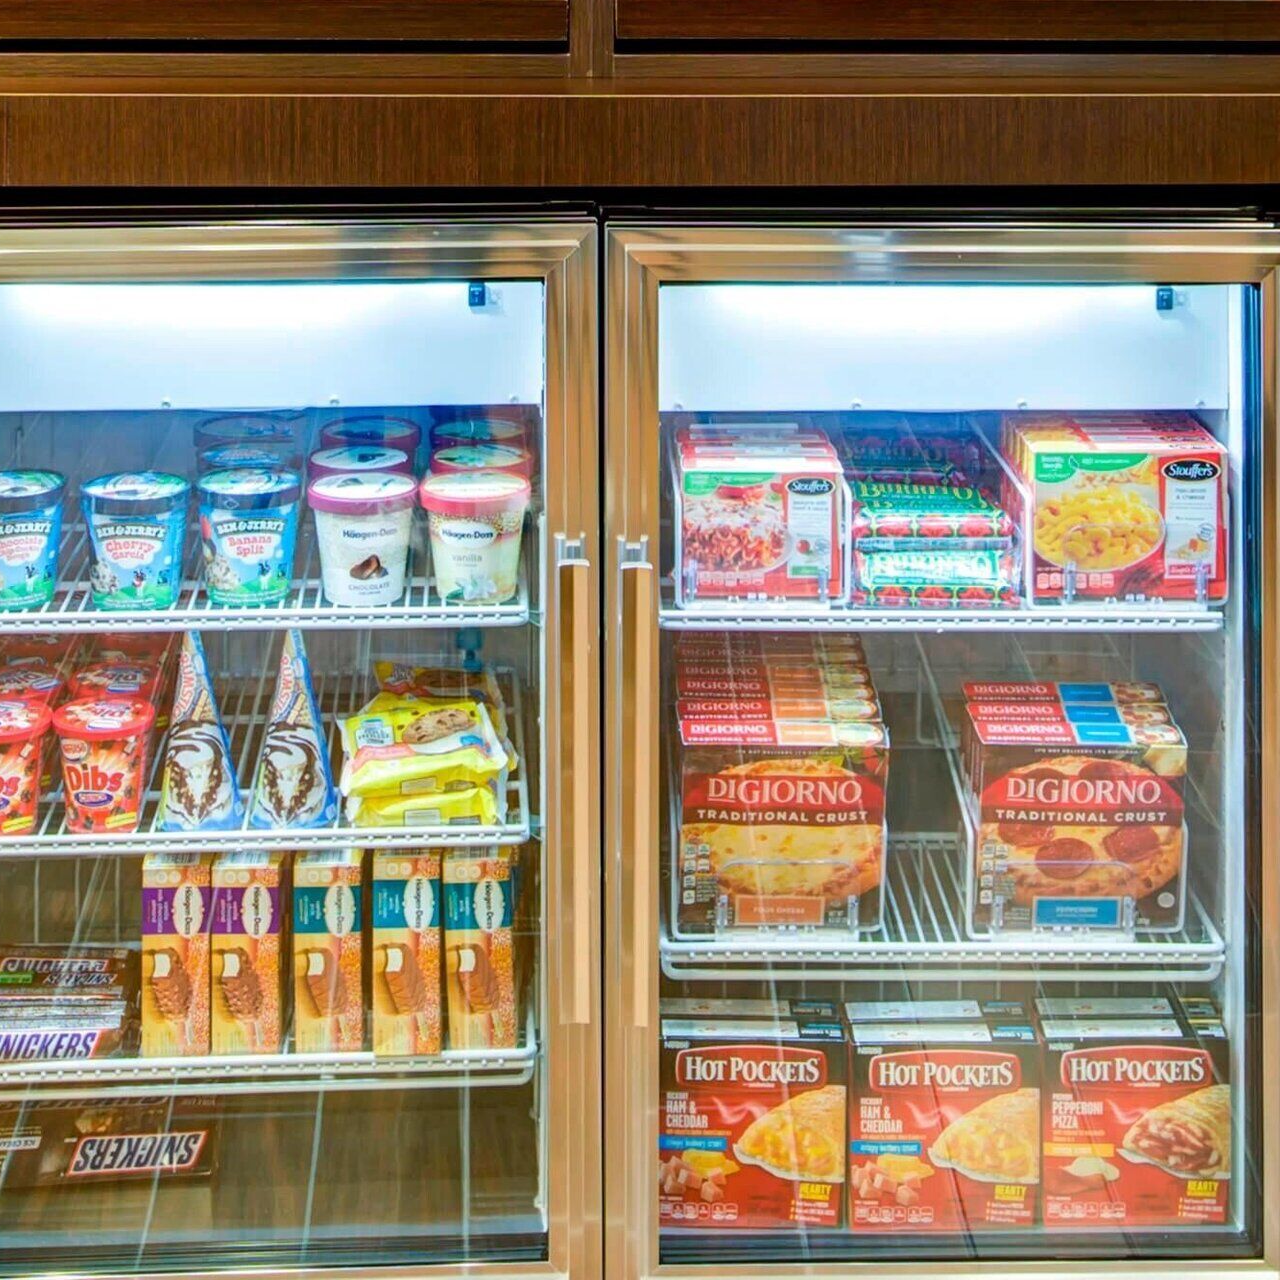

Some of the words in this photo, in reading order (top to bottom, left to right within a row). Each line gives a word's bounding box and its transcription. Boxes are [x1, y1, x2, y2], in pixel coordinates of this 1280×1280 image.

[1168, 464, 1214, 479] Stouffer's
[790, 480, 832, 494] Stouffer's
[14, 522, 52, 533] JERRY'S
[126, 526, 166, 538] JERRY'S
[217, 523, 238, 533] BEN
[245, 521, 284, 533] JERRY'S
[105, 540, 154, 554] Cherry
[228, 534, 272, 548] Banana
[236, 544, 266, 557] Split
[451, 552, 483, 564] vanilla
[348, 581, 391, 591] CHOCOLATE
[690, 723, 768, 734] DIGIORNO
[987, 723, 1065, 734] DIGIORNO
[66, 765, 124, 794] Dibs
[707, 778, 862, 804] DIGIORNO
[1006, 777, 1161, 805] DIGIORNO
[685, 1056, 727, 1081] HOT
[729, 1056, 821, 1084] POCKETS
[878, 1061, 920, 1086] HOT
[923, 1061, 1014, 1088] POCKETS
[1069, 1056, 1111, 1083] HOT
[1114, 1056, 1205, 1084] POCKETS
[666, 1101, 688, 1114] HAM
[689, 1102, 697, 1114] &
[860, 1106, 882, 1119] HAM
[882, 1107, 891, 1119] &
[1052, 1101, 1104, 1116] PEPPERONI
[666, 1114, 709, 1129] CHEDDAR
[860, 1120, 903, 1134] CHEDDAR
[1052, 1115, 1079, 1130] PIZZA
[72, 1131, 202, 1173] SNICKERS
